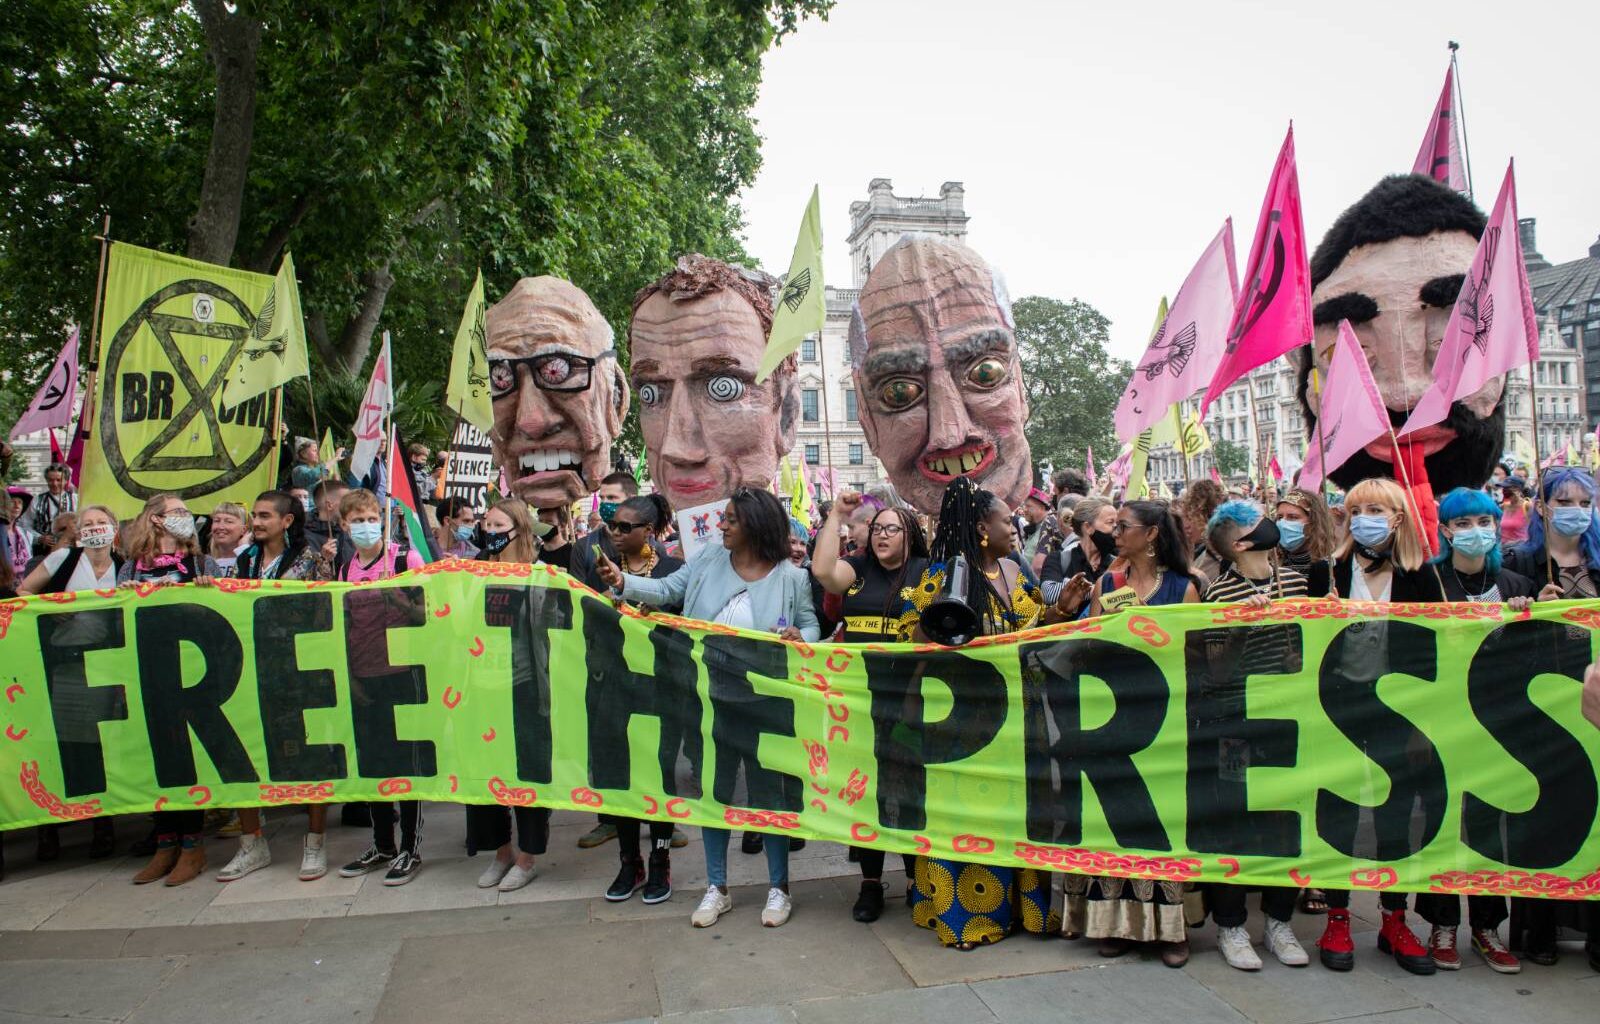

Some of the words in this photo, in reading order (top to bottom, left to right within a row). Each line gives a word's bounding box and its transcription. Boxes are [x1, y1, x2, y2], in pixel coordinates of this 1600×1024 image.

[449, 460, 489, 476] SILENCE
[864, 620, 880, 629] THE
[37, 586, 437, 798] FREE
[485, 584, 804, 812] THE
[861, 620, 1598, 868] PRESS
